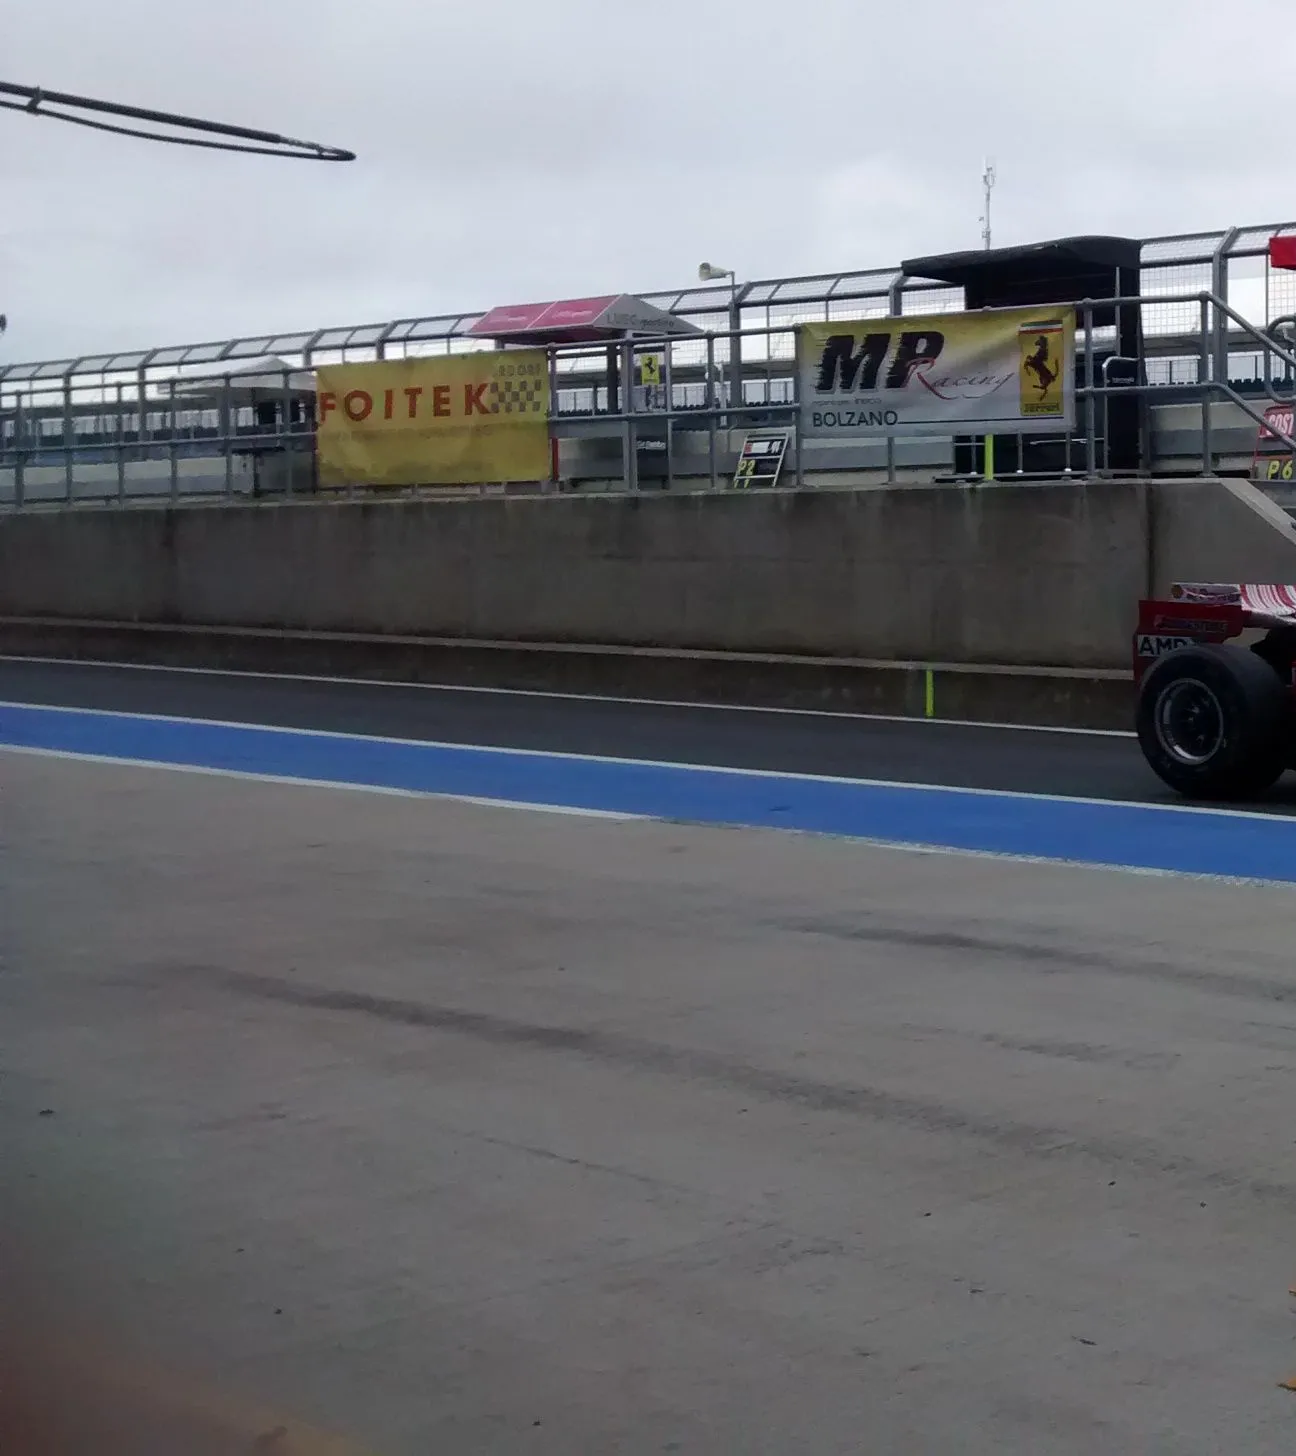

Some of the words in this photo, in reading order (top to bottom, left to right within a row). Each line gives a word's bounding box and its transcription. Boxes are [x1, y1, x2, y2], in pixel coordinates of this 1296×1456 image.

[814, 331, 945, 393] MP
[319, 382, 492, 422] FOITEK
[812, 410, 898, 427] BOLZANO
[1267, 460, 1293, 480] P6
